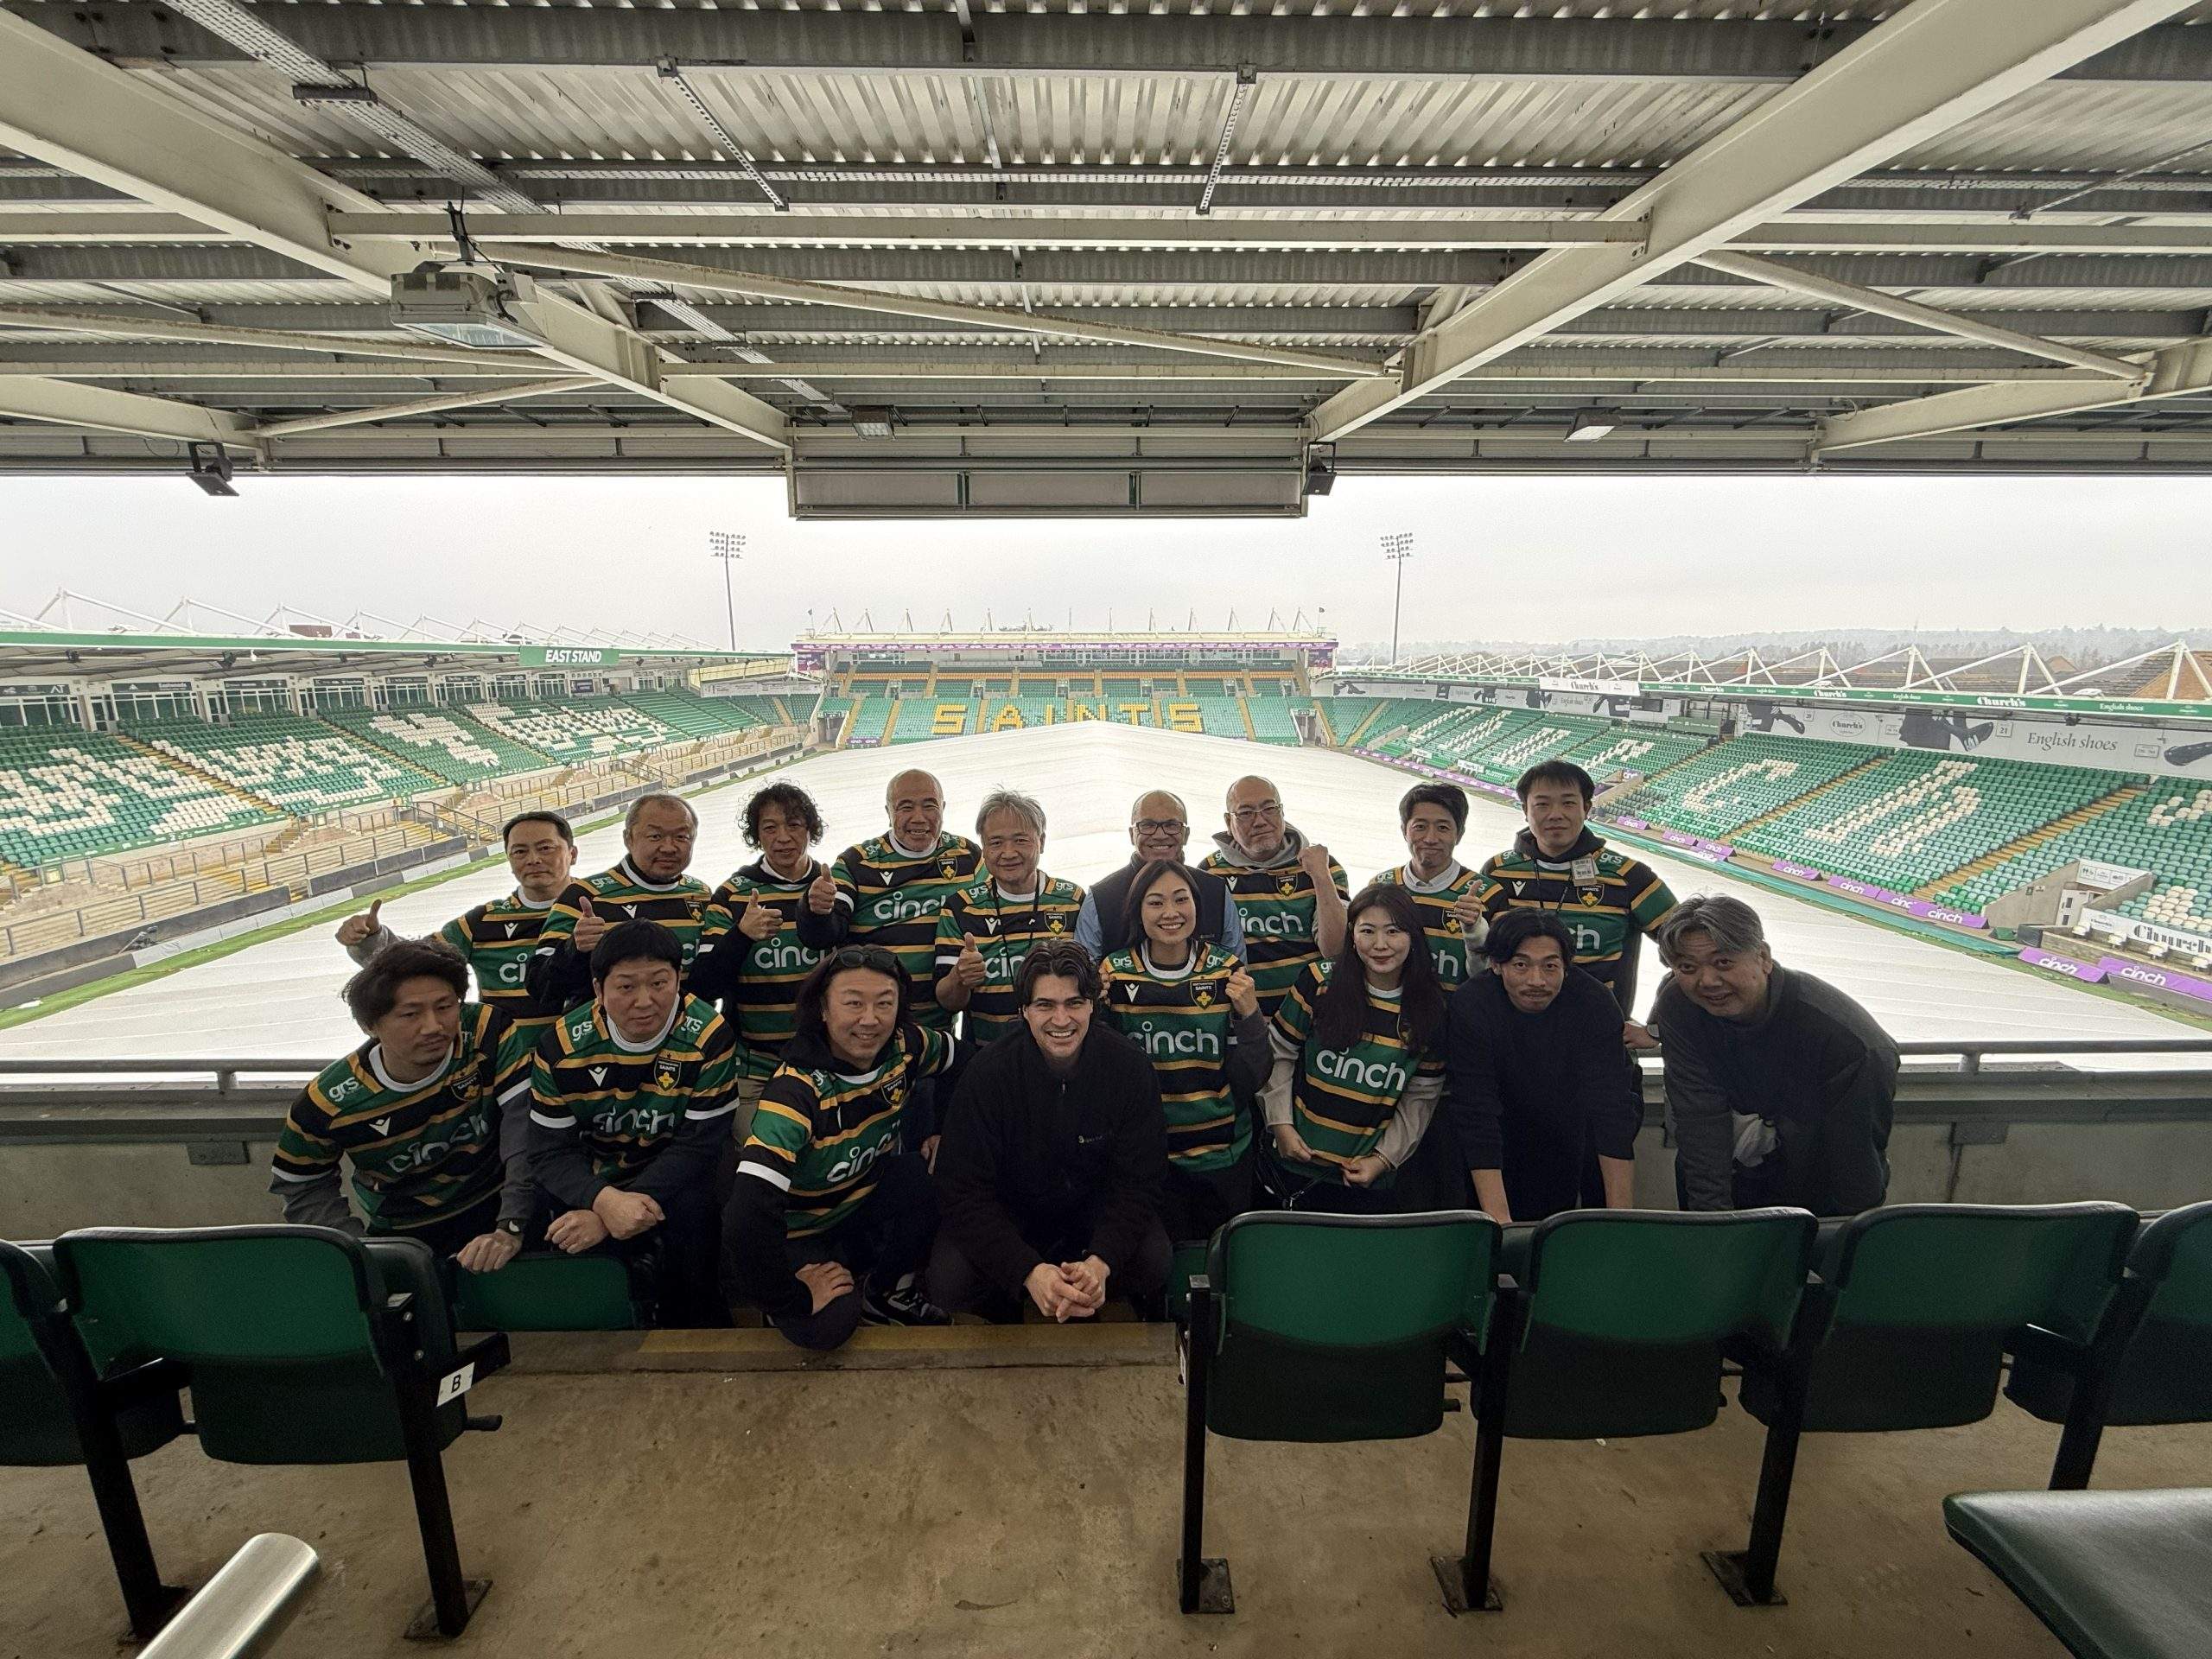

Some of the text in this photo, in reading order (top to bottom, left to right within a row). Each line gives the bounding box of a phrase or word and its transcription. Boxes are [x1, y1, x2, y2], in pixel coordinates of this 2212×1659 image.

[545, 650, 601, 663] EAST STAND
[1571, 681, 1599, 690] Church's
[1977, 696, 2026, 707] Church's
[2099, 703, 2124, 712] English
[931, 703, 1203, 734] SAINTS
[1833, 721, 1863, 729] Church's
[2027, 732, 2076, 751] English
[2078, 734, 2119, 751] shoes
[1706, 842, 1722, 853] cinch
[1599, 852, 1623, 864] grs
[1783, 864, 1804, 877] cinch
[591, 876, 616, 888] grs
[1056, 881, 1074, 892] grs
[1465, 880, 1488, 891] gs
[1840, 880, 1864, 894] cinch
[969, 886, 988, 899] grs
[874, 891, 946, 920] cinc
[1891, 895, 1916, 909] cinc
[1238, 908, 1303, 934] inch
[1928, 908, 1963, 924] cinch
[985, 947, 1027, 979] cin
[1113, 956, 1133, 969] grs
[1320, 961, 1336, 973] gr
[2039, 957, 2077, 975] cinch
[2121, 965, 2167, 986] cinch
[1316, 1046, 1406, 1091] cinch
[329, 1077, 359, 1102] grs
[451, 1374, 461, 1393] B
